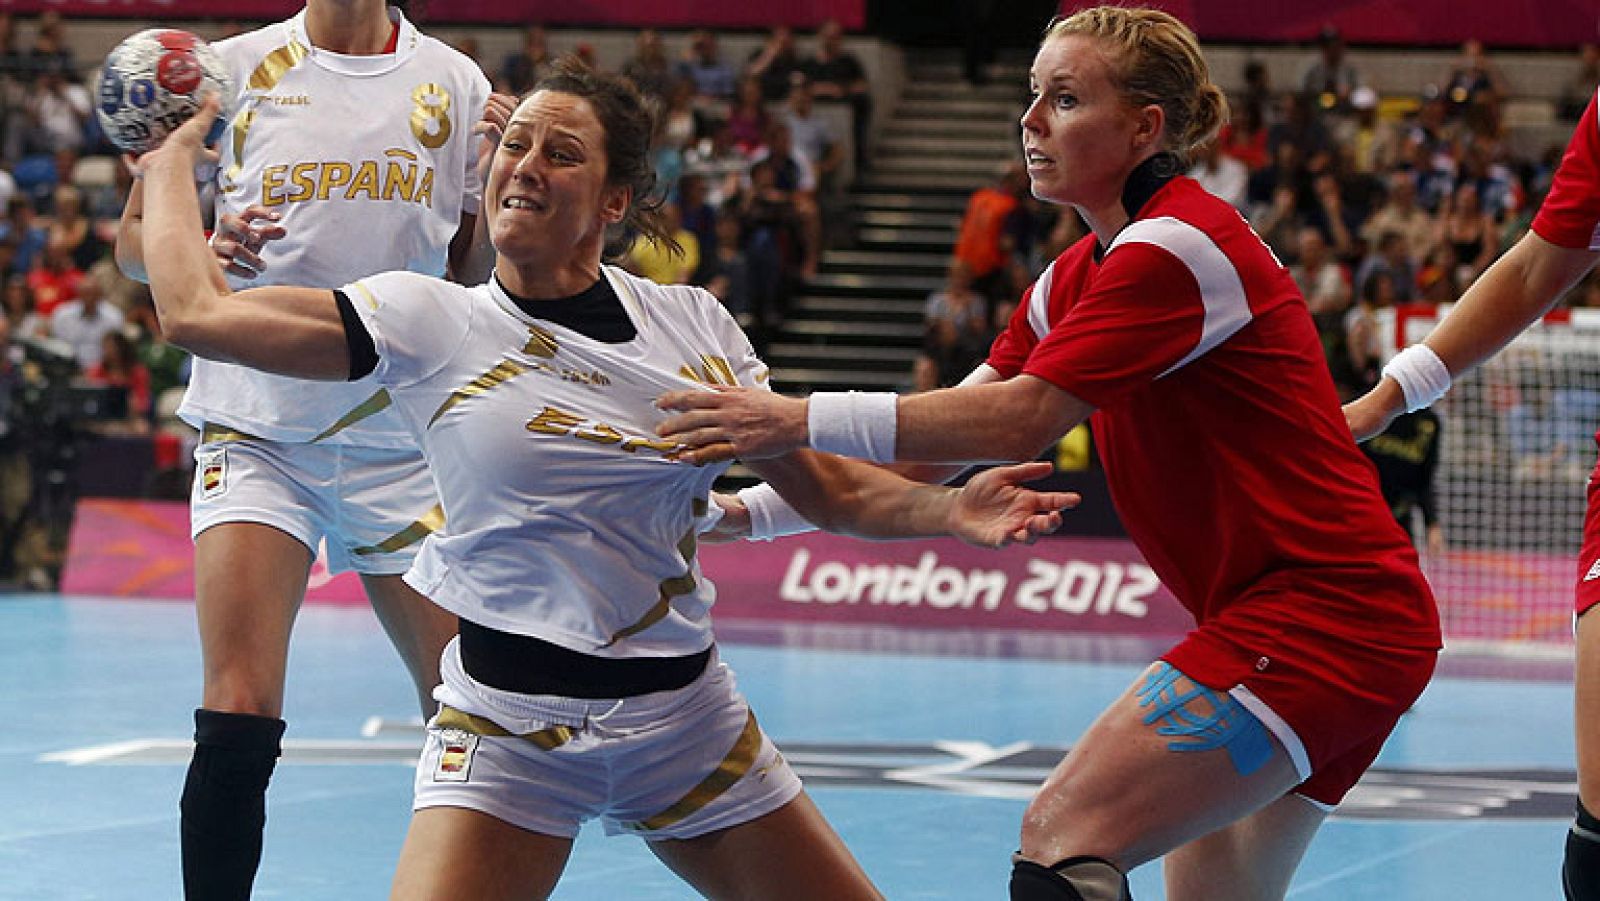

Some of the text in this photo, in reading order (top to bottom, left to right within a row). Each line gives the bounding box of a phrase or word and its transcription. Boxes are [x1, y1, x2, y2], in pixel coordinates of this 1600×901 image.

[410, 83, 451, 148] 8
[263, 149, 433, 208] ESPAÑA
[780, 549, 1160, 618] London 2012
